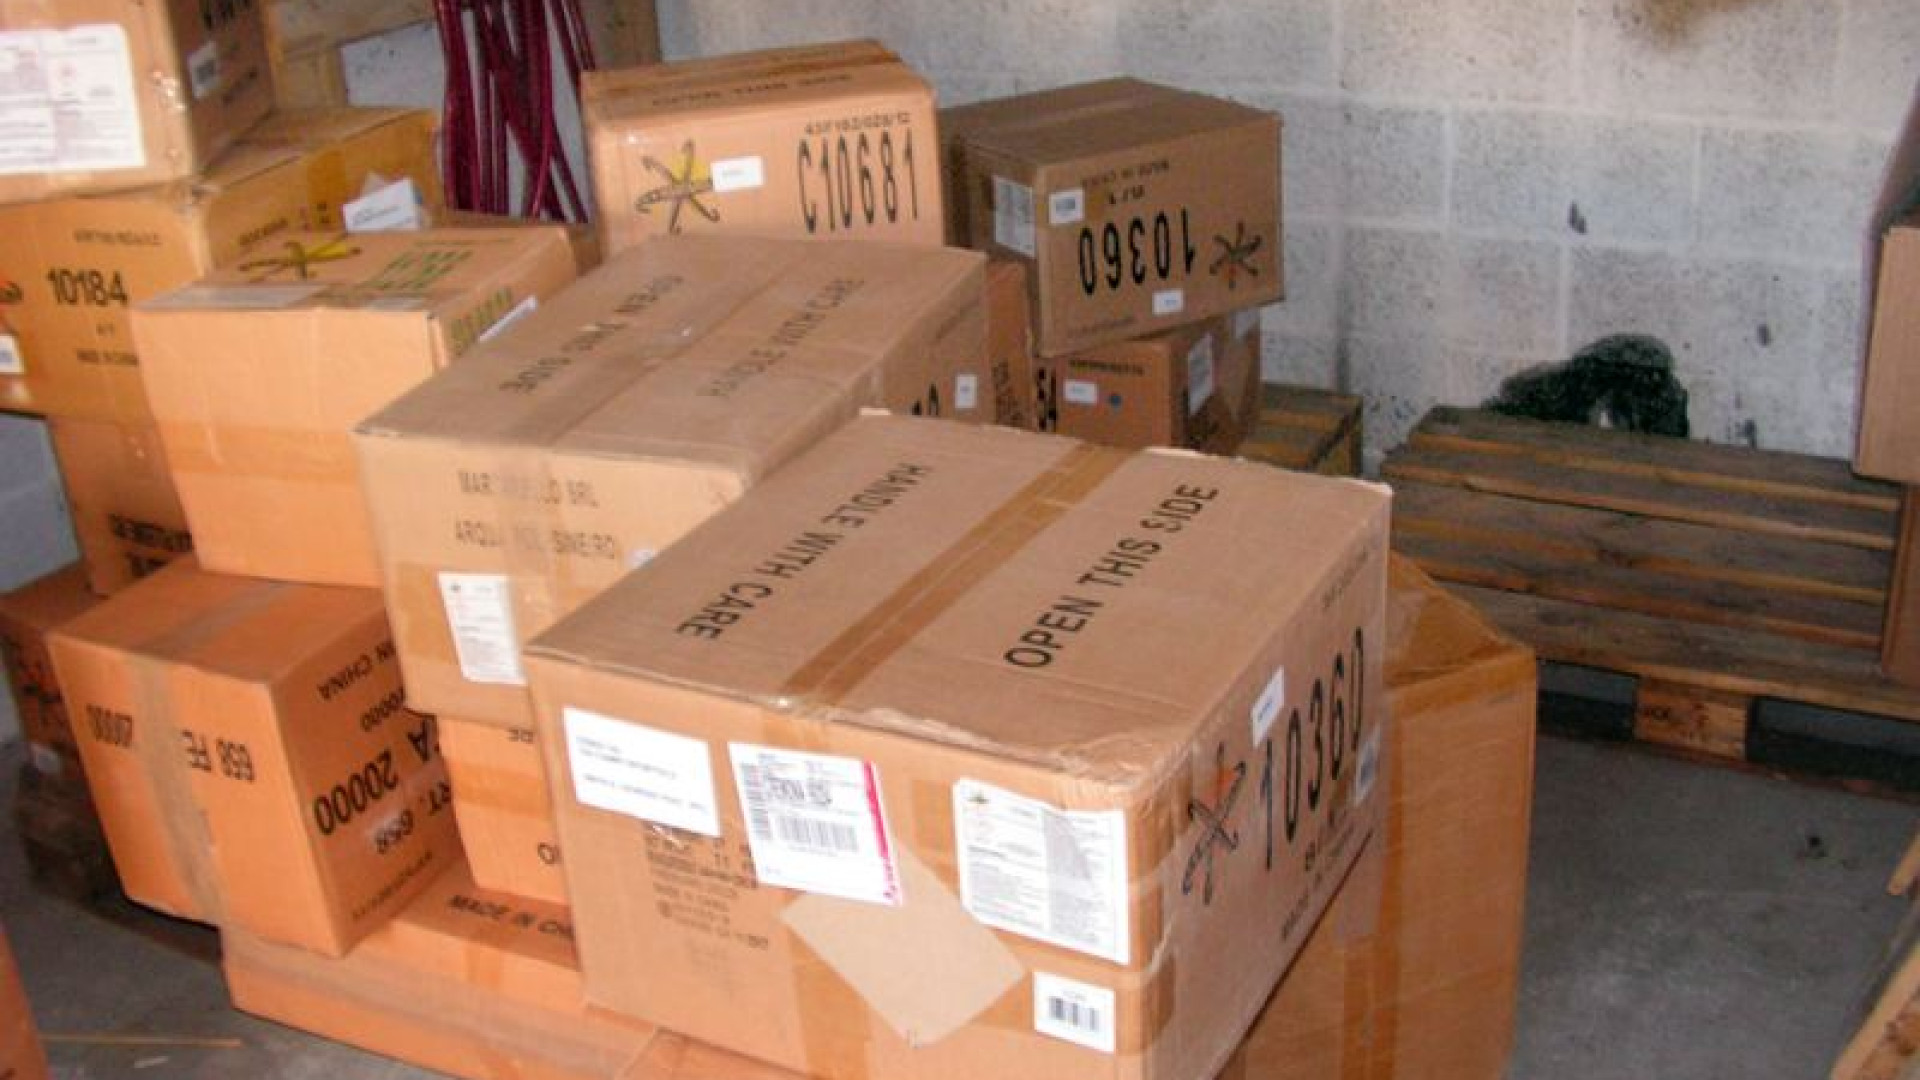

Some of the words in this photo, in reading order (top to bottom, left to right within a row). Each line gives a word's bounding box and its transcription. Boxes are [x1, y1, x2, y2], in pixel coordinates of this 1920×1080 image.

[799, 127, 917, 233] C10681
[46, 267, 128, 307] 10184
[1078, 207, 1197, 297] 10360
[824, 461, 932, 528] HANDLE
[760, 529, 843, 580] WITH
[1003, 595, 1105, 669] OPEN
[1076, 537, 1161, 588] THIS
[1140, 483, 1220, 534] SIDE
[677, 580, 773, 640] CARE
[317, 654, 372, 702] CHINA
[1260, 626, 1365, 872] 10360
[312, 748, 399, 836] 20000
